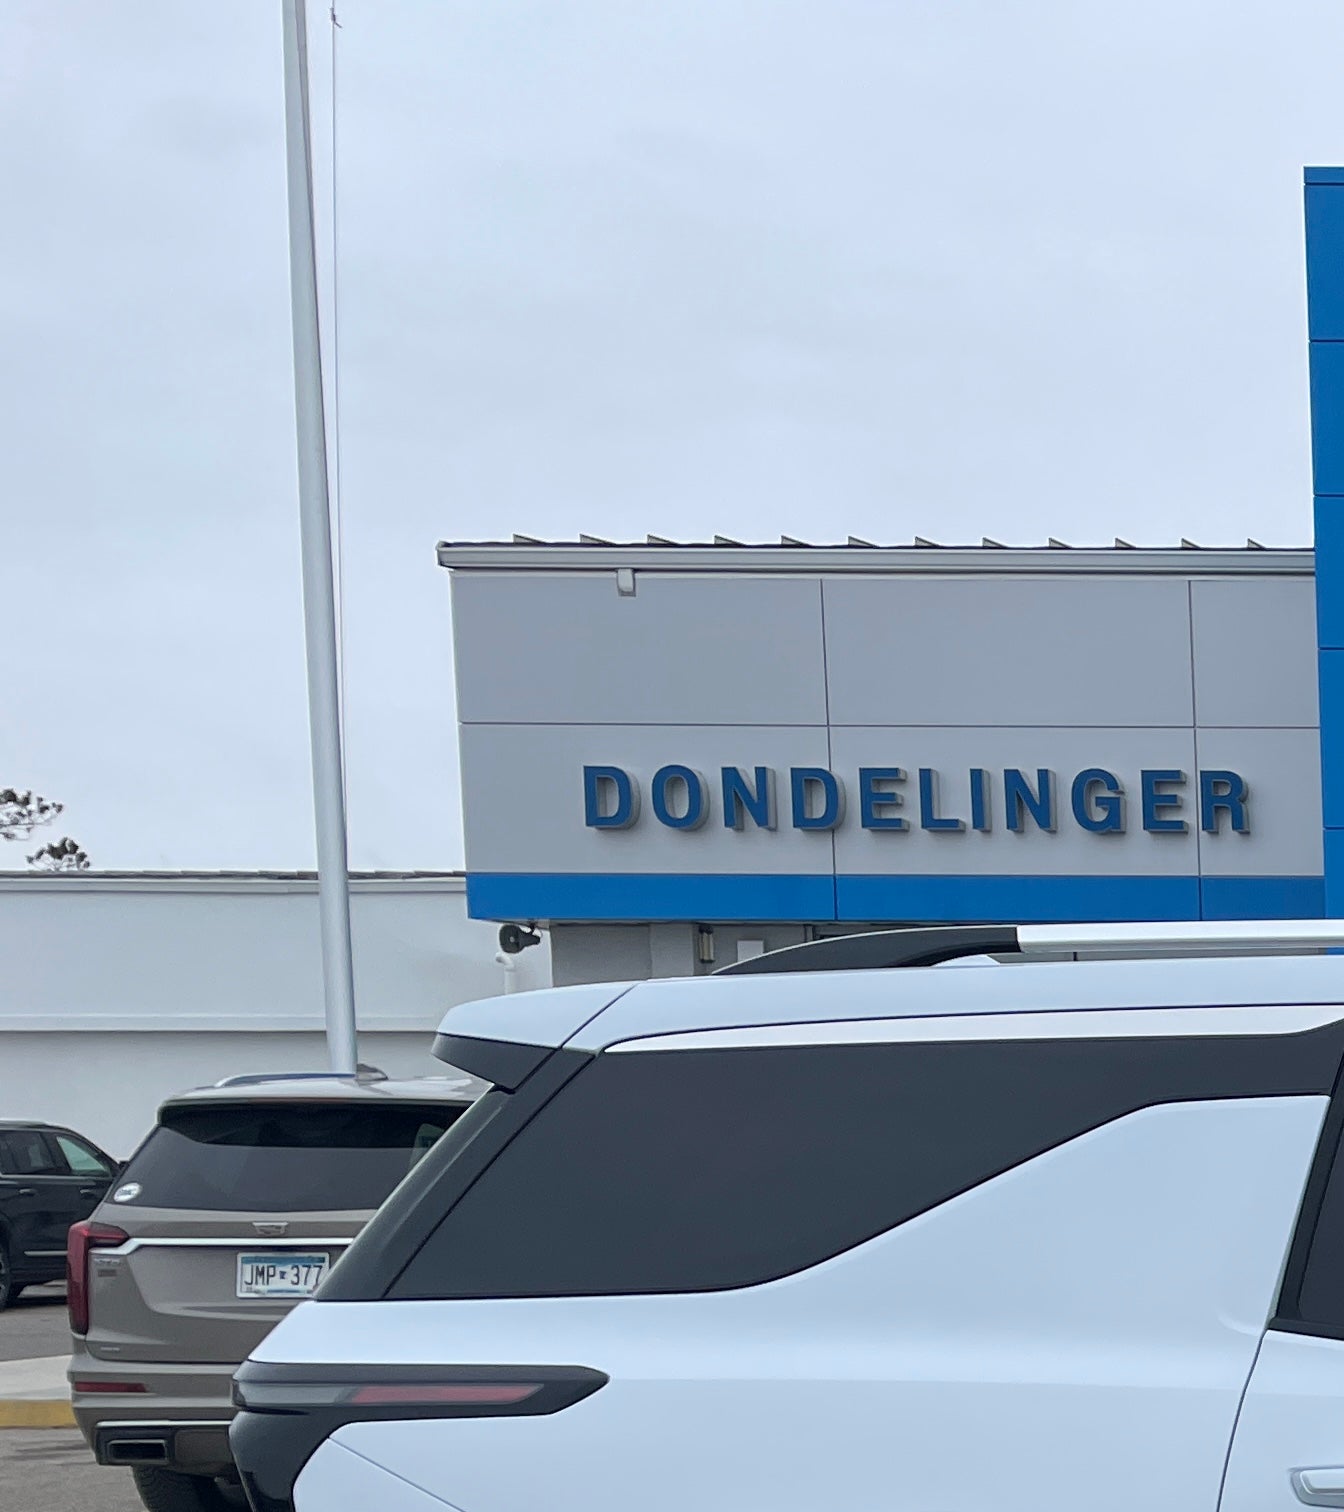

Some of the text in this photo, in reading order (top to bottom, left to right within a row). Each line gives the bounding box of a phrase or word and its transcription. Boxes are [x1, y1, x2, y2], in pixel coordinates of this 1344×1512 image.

[582, 764, 1250, 835] DONDELINGER
[244, 1265, 323, 1286] JMP 377
